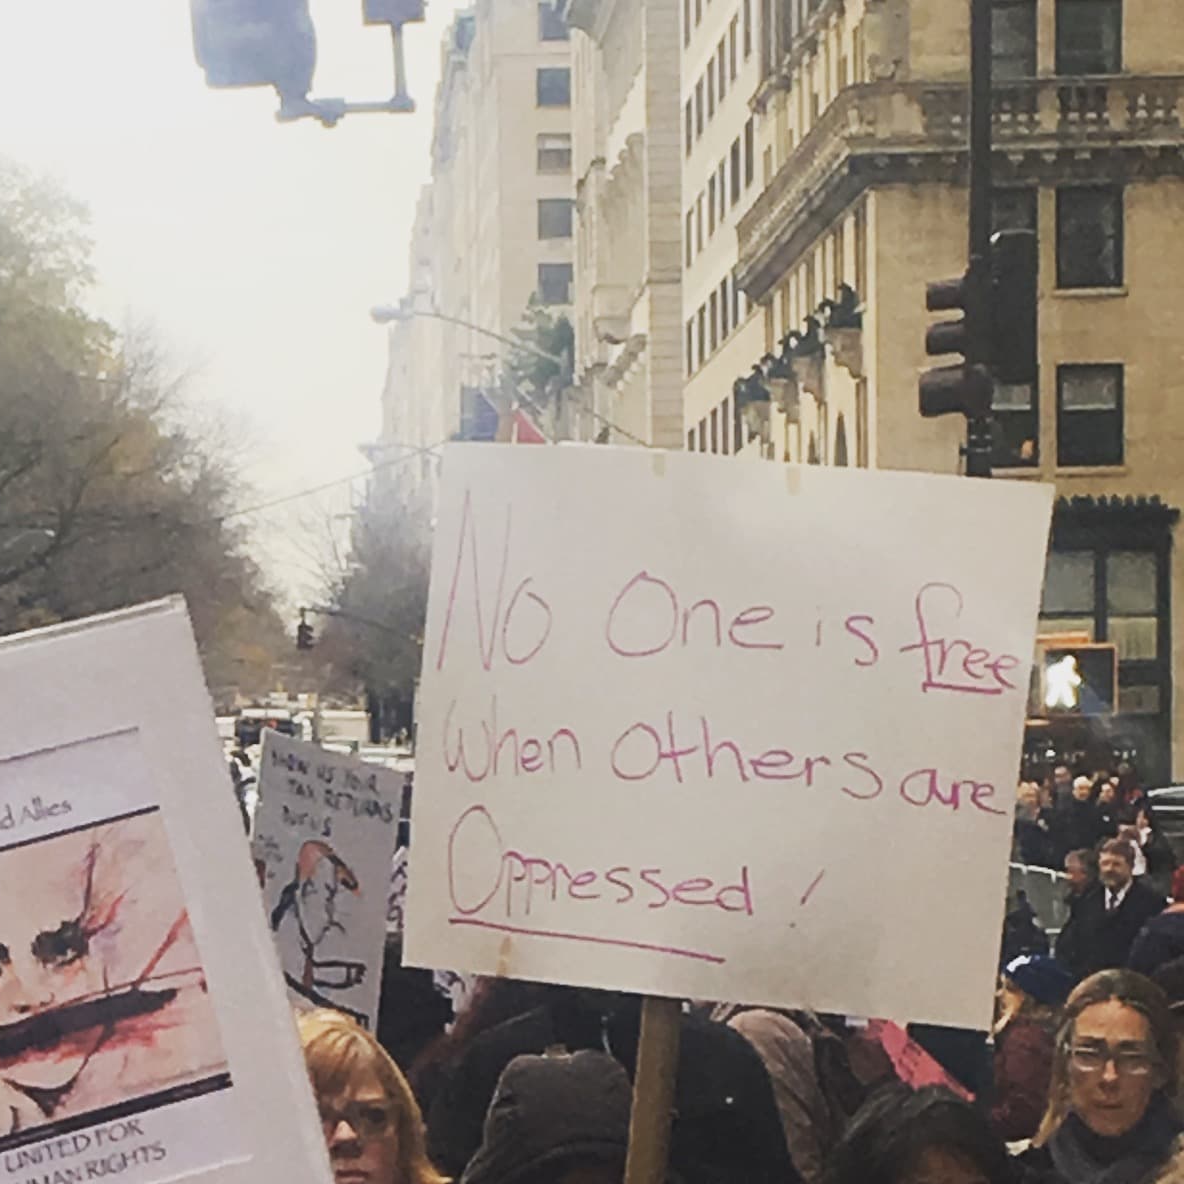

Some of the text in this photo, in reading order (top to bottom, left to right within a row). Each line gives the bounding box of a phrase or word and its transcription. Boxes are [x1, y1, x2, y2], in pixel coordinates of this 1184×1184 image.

[436, 488, 1020, 691] No One is free
[442, 694, 582, 782] When
[899, 768, 1007, 815] are
[20, 795, 73, 825] Allies
[4, 1118, 145, 1174] UNITED FOR
[83, 1140, 168, 1180] RIGHTS
